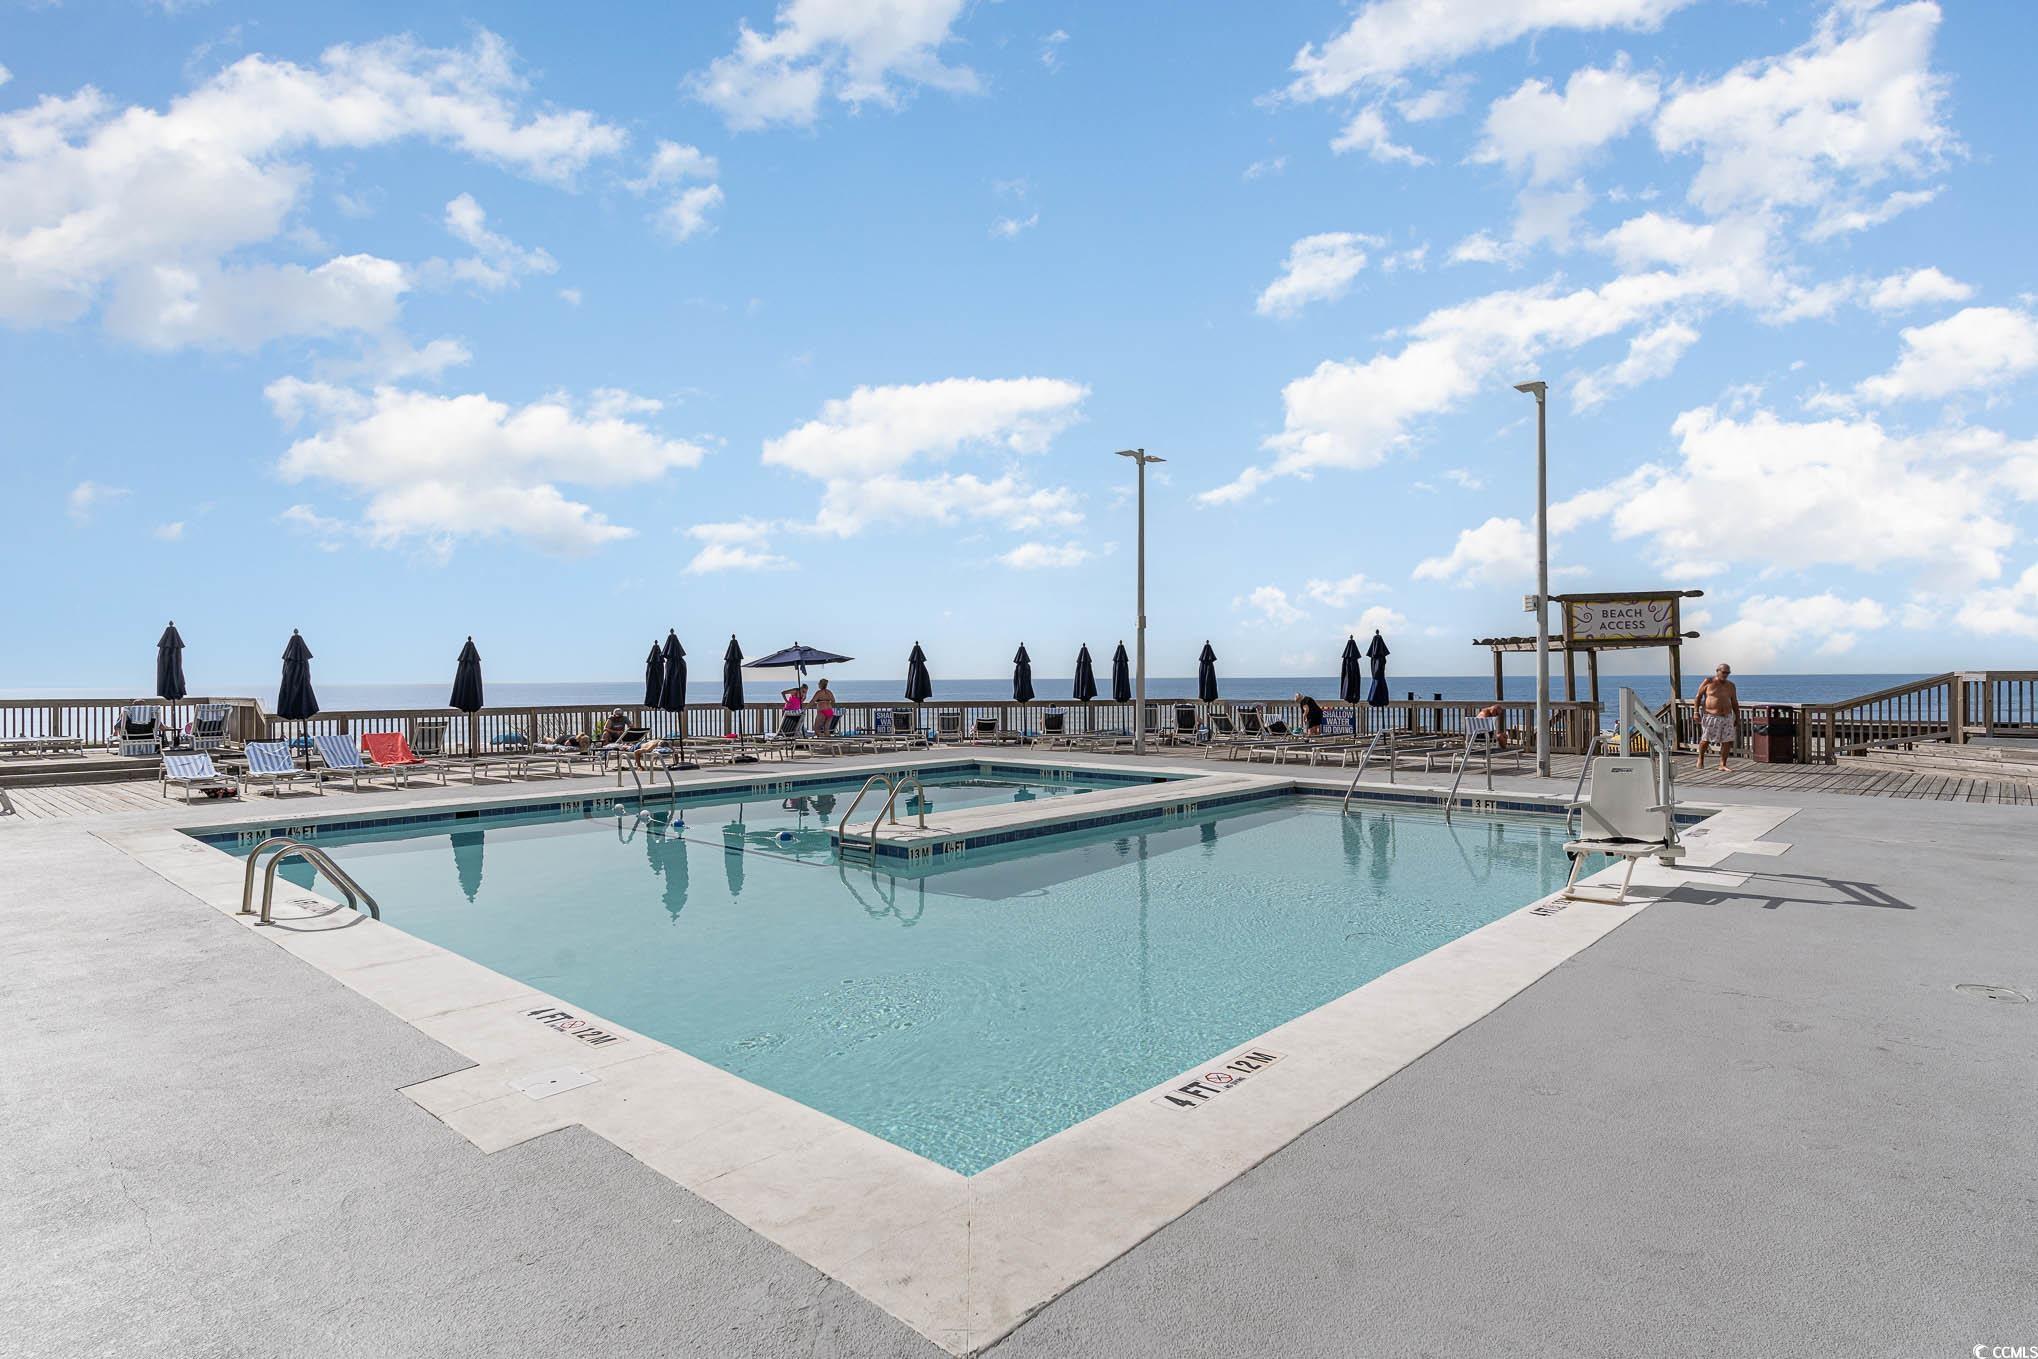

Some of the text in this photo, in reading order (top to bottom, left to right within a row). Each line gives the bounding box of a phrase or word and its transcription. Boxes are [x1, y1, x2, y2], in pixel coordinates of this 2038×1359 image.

[1602, 609, 1642, 618] BEACH
[1599, 620, 1646, 630] ACCESS
[1322, 710, 1354, 718] SHALLOW
[1332, 726, 1354, 734] DIVING
[1475, 800, 1481, 808] 3
[1485, 800, 1496, 809] FT
[536, 1012, 574, 1024] FT
[1178, 1081, 1221, 1099] FT
[1164, 1095, 1197, 1107] 4
